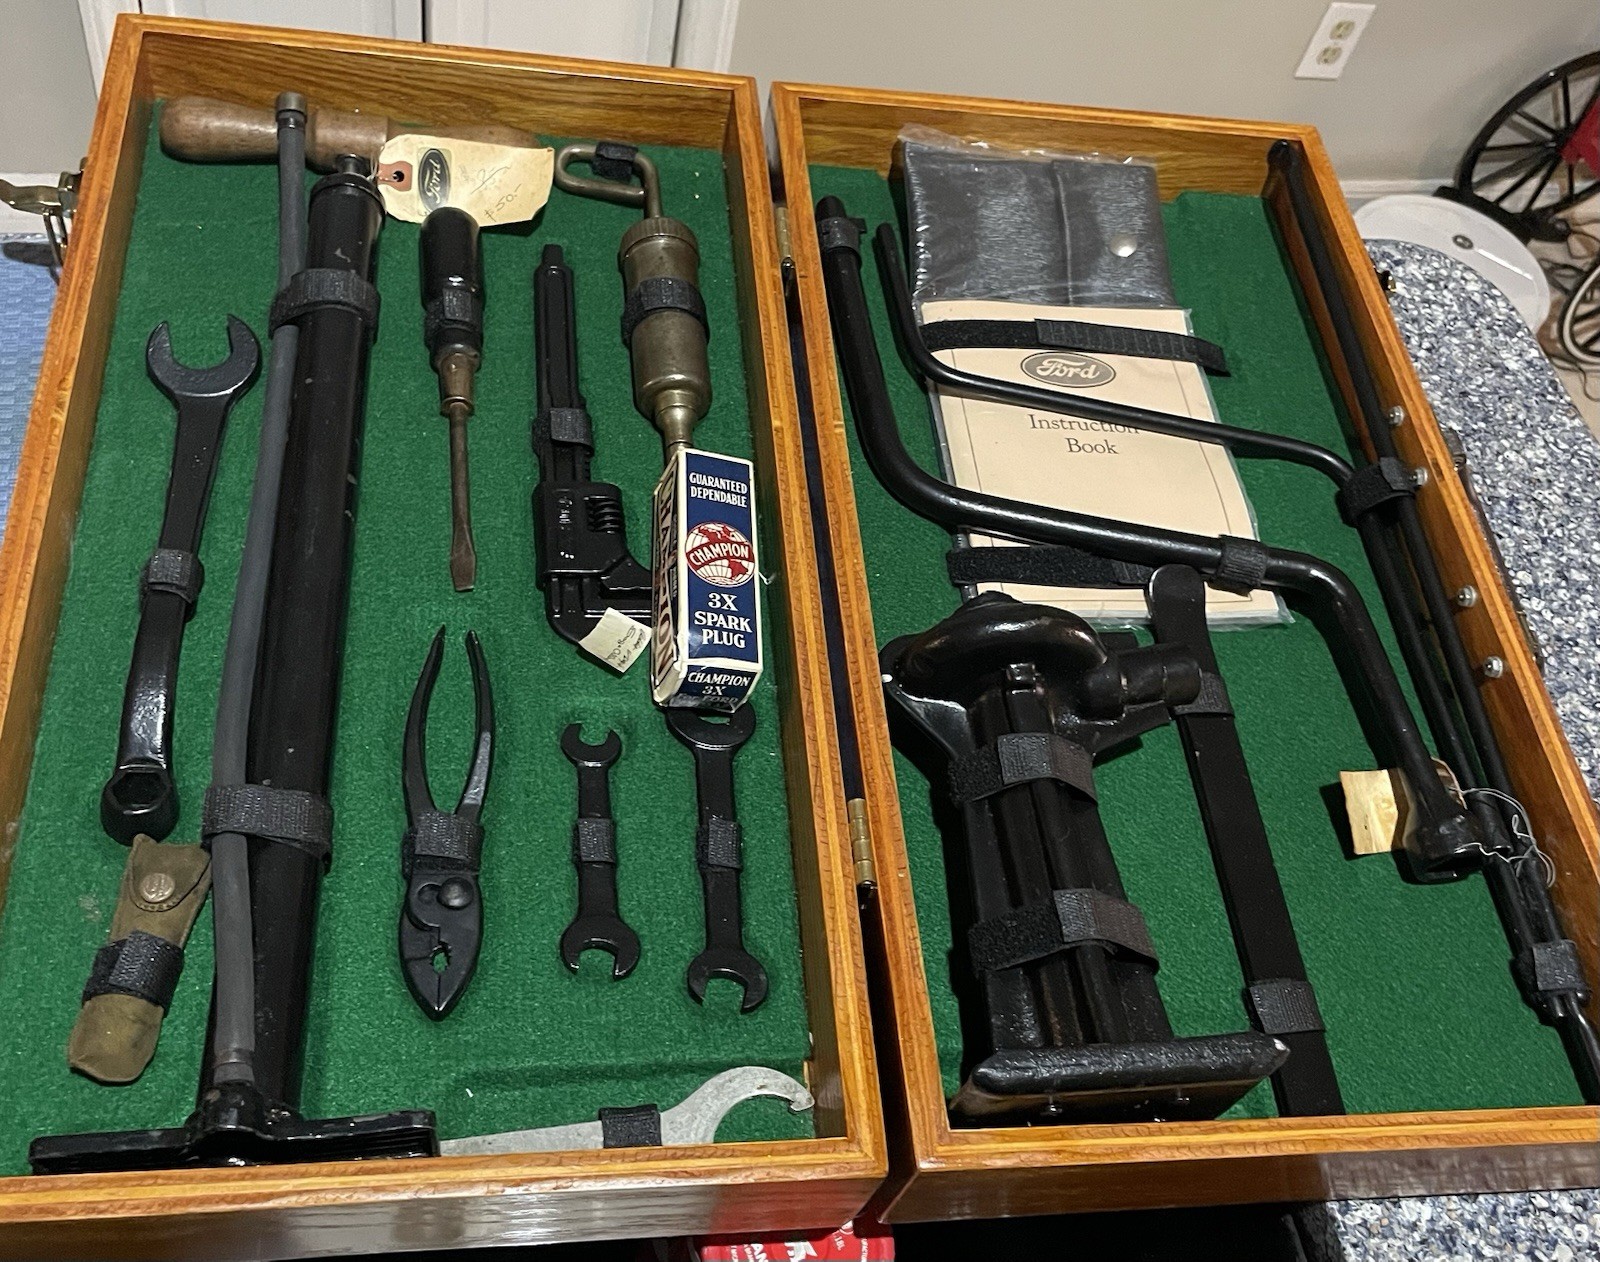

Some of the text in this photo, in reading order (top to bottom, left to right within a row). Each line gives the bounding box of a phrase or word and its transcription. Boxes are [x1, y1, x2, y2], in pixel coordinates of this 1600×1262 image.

[425, 158, 441, 205] Ford
[1036, 358, 1100, 379] Ford
[1065, 437, 1119, 454] Book
[689, 472, 748, 494] GUARANTEED
[690, 486, 747, 508] DEPENDABLE
[689, 543, 749, 566] CHAMPION
[708, 592, 738, 611] 3X
[694, 611, 753, 633] SPARK
[702, 628, 746, 648] PLUG
[687, 672, 751, 687] CHAMPION
[702, 686, 727, 695] 3X
